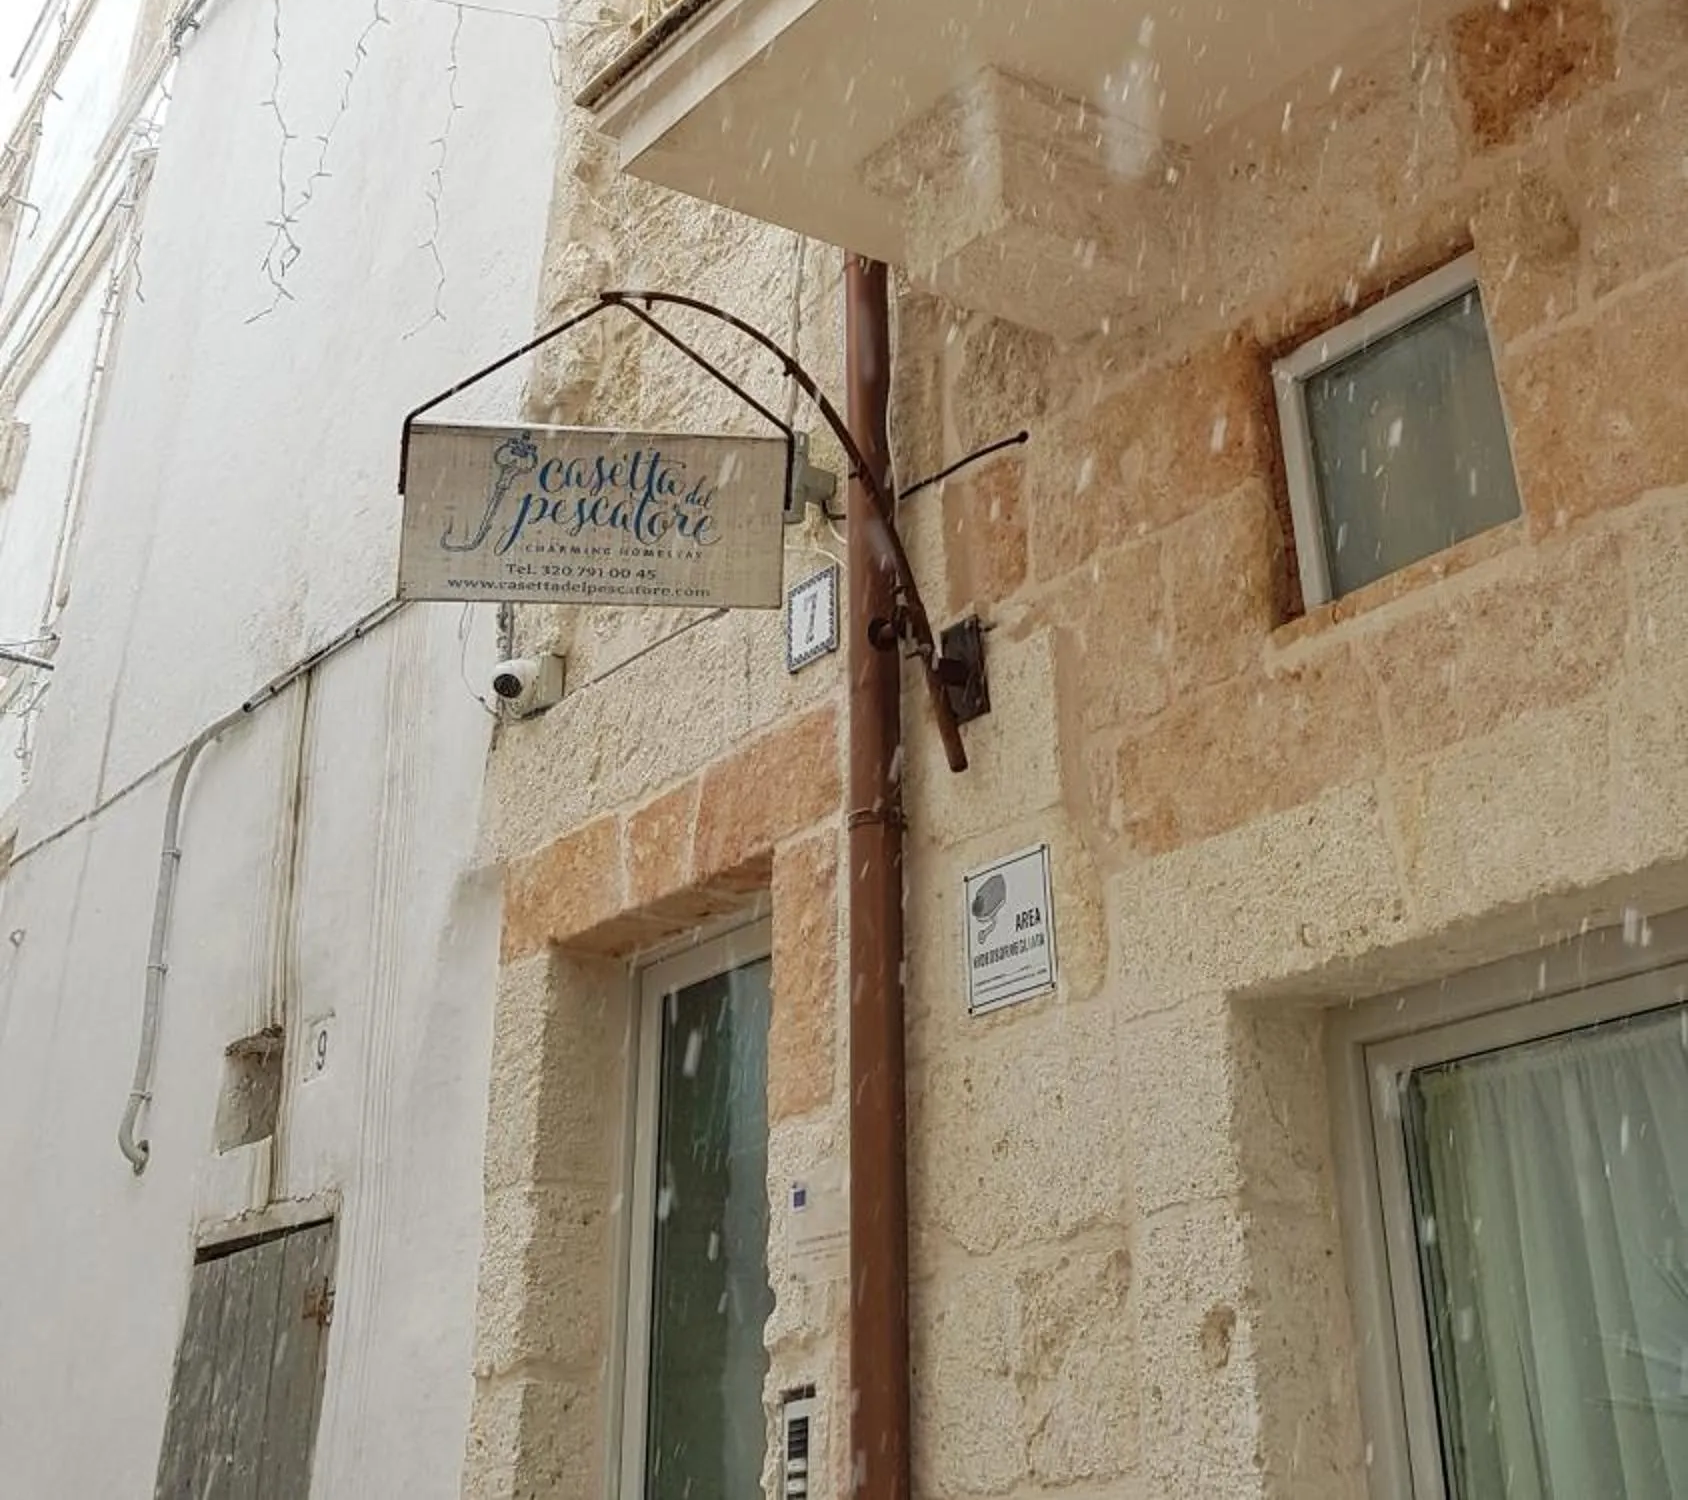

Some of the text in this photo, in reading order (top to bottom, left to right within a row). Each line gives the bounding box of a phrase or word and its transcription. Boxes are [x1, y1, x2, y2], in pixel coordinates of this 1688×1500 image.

[539, 451, 718, 509] casetta del
[494, 491, 722, 555] pescatore
[525, 544, 612, 557] CHARMING
[541, 565, 573, 577] 320
[635, 569, 657, 580] 45
[1015, 907, 1041, 932] AREA
[315, 1029, 328, 1071] 9
